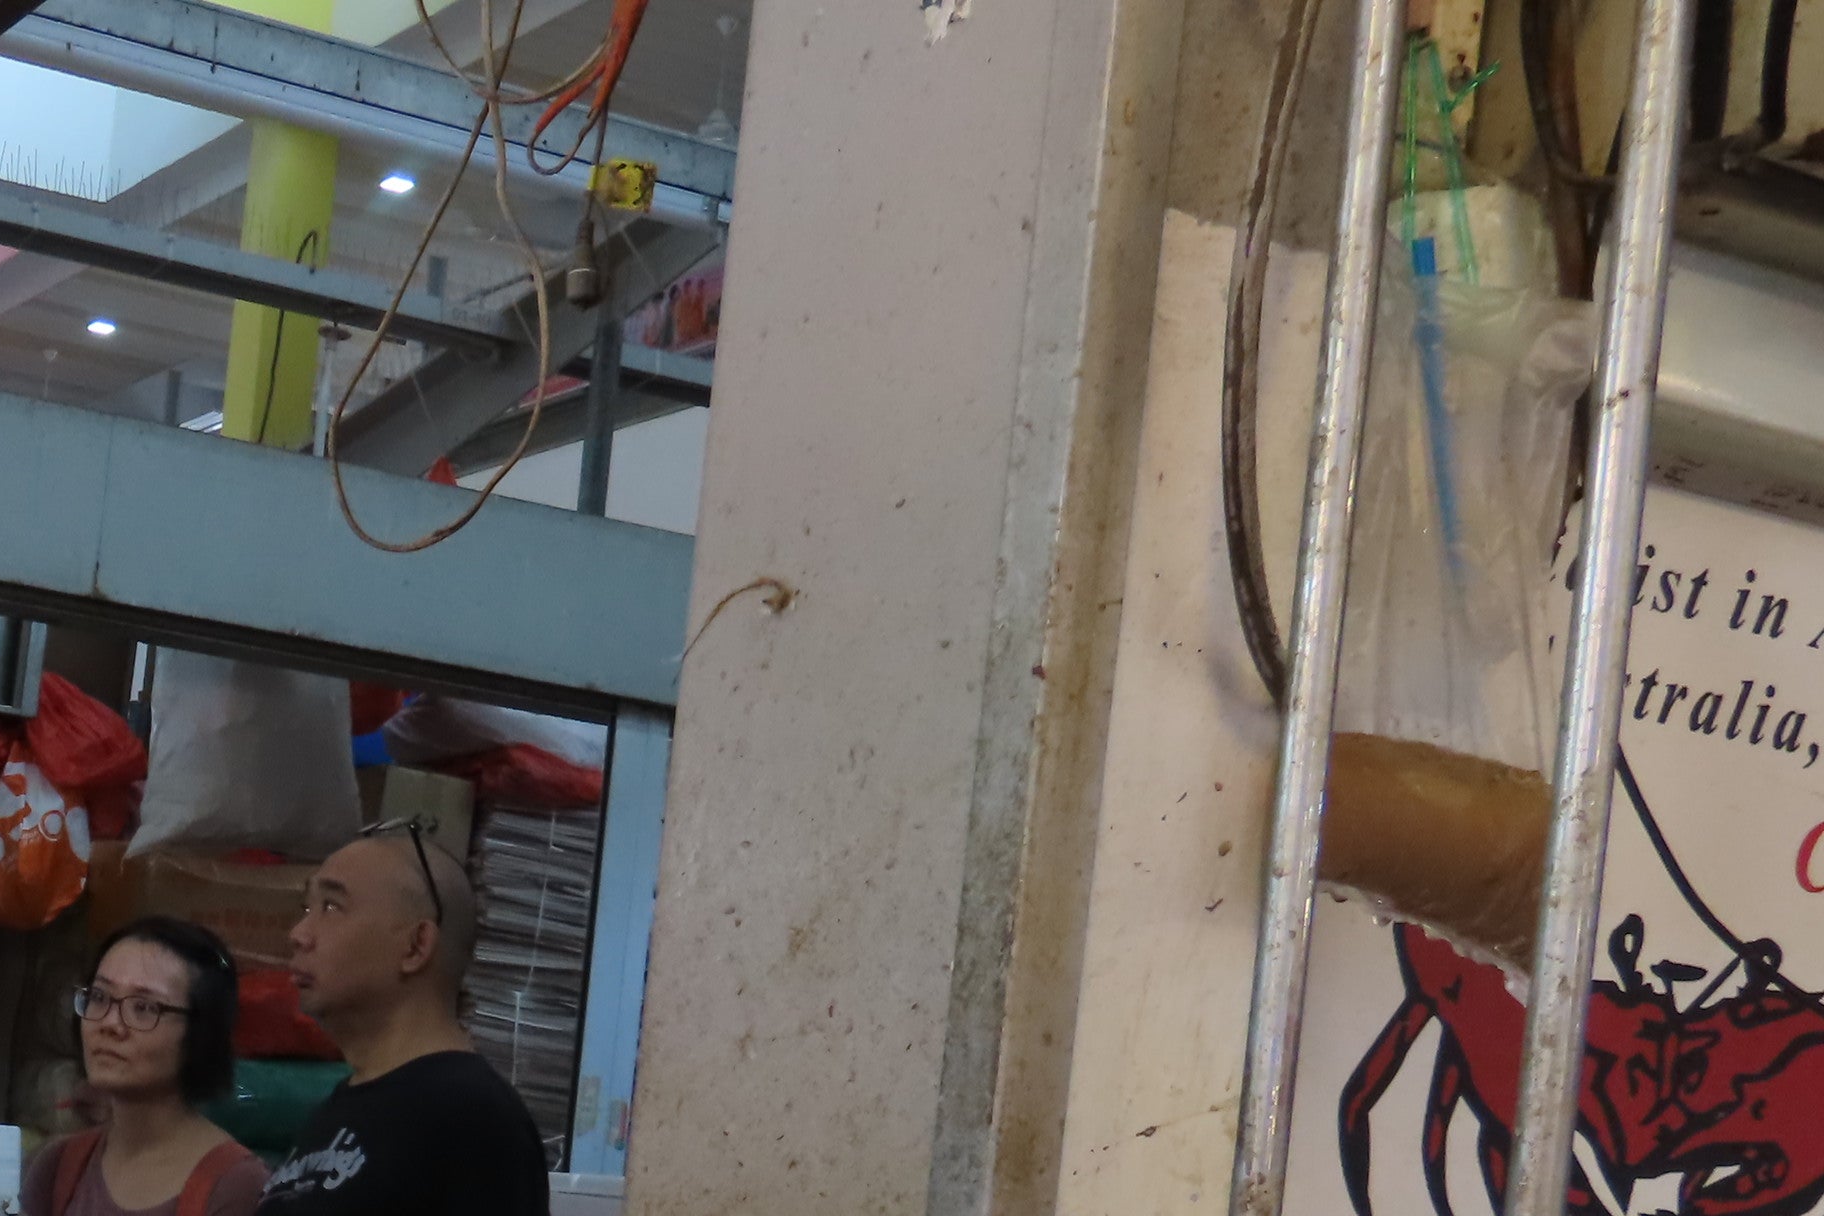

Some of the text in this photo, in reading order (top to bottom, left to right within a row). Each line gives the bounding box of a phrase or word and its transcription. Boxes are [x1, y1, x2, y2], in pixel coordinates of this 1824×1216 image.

[1628, 545, 1789, 639] ist in
[1625, 668, 1819, 769] tralia,
